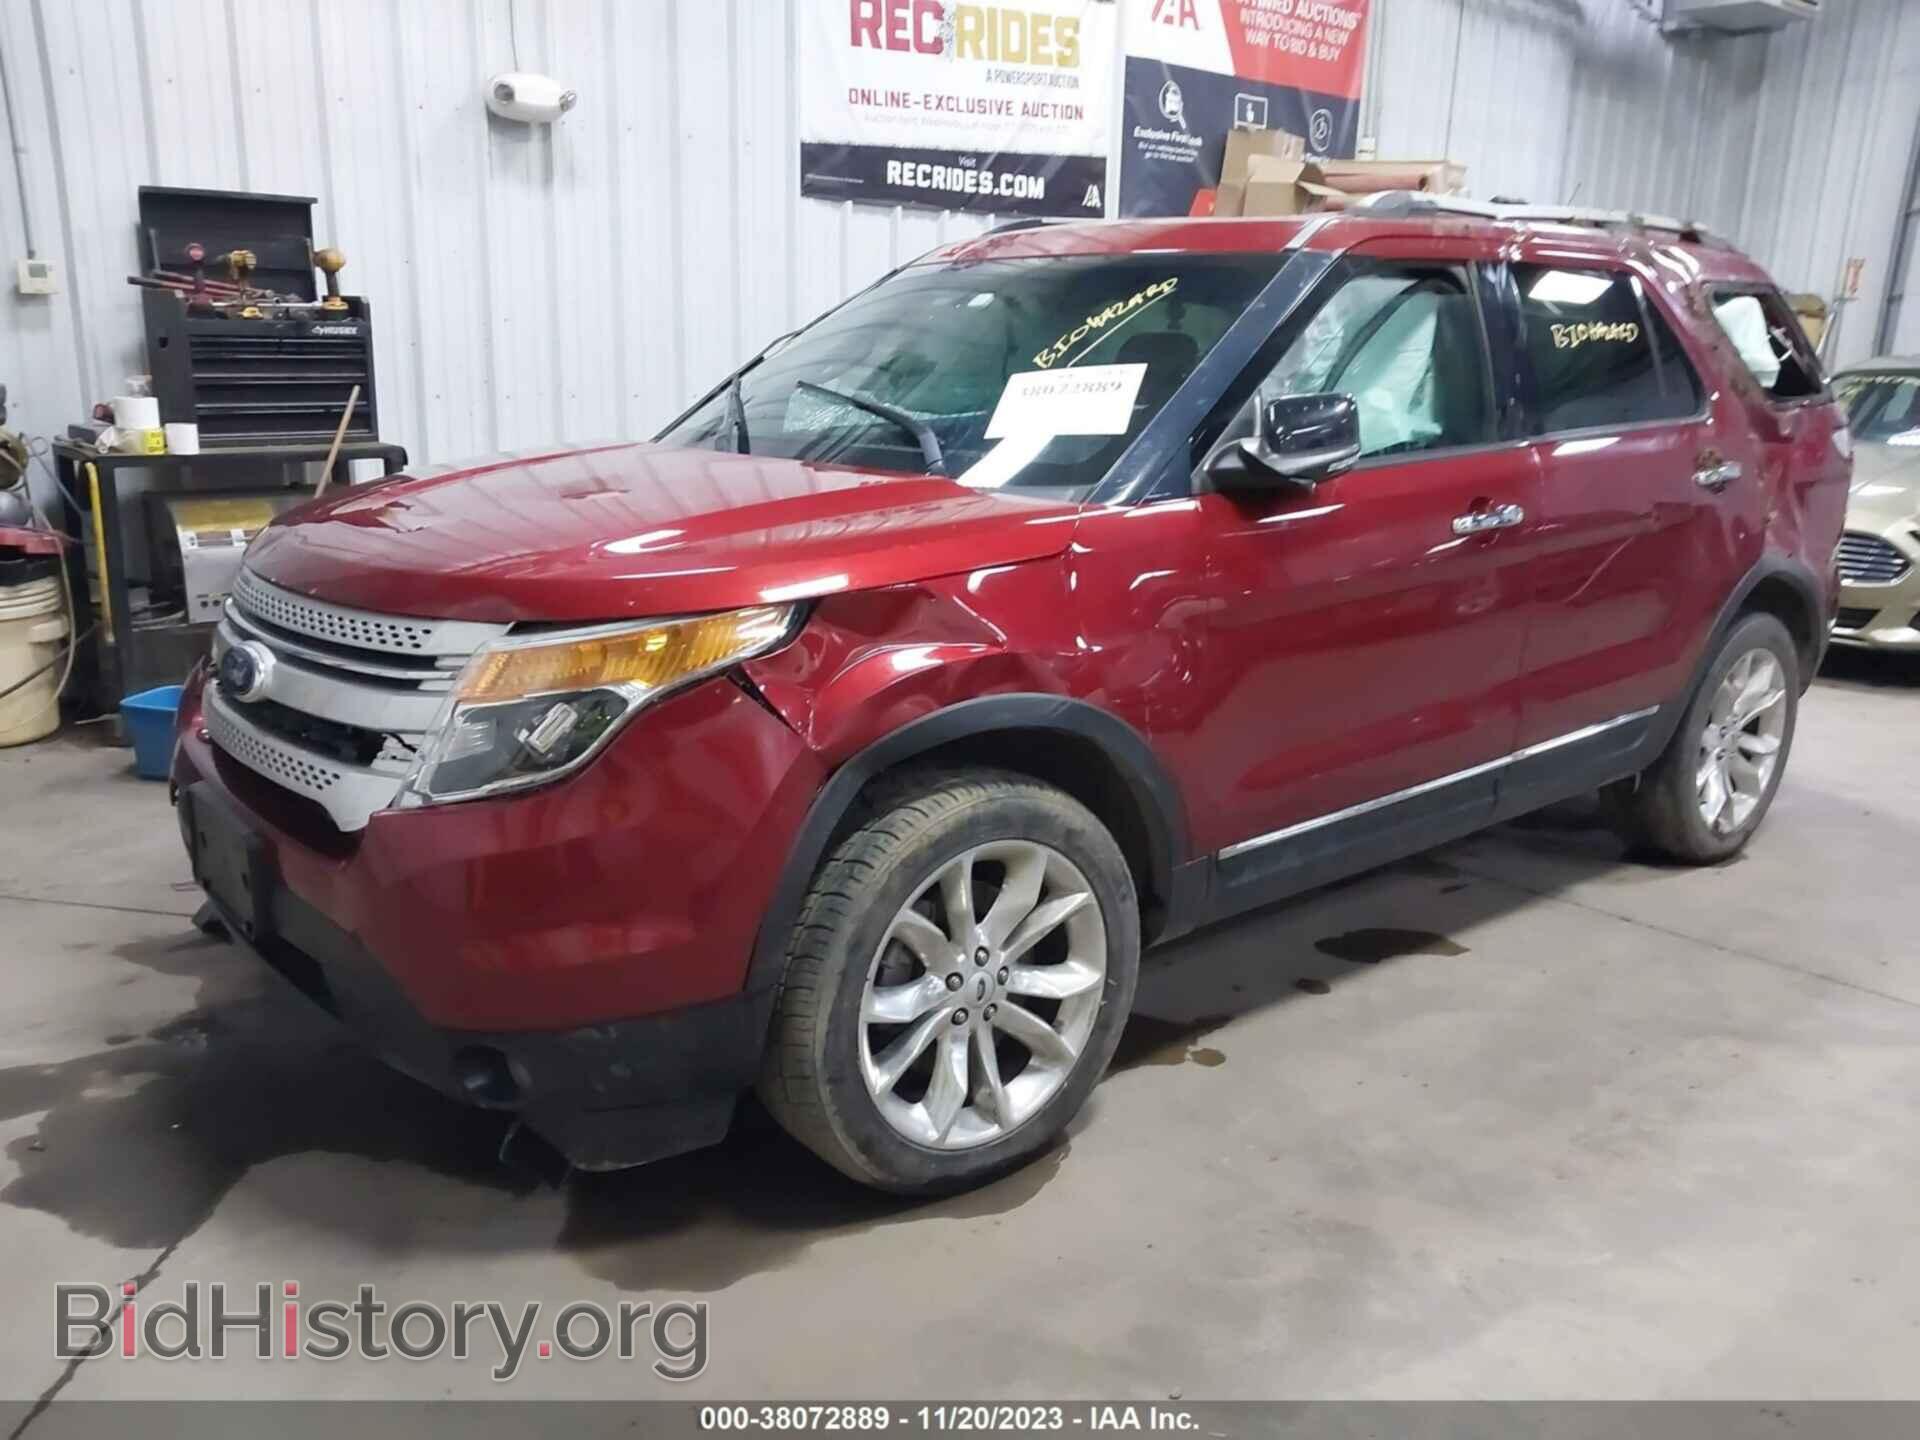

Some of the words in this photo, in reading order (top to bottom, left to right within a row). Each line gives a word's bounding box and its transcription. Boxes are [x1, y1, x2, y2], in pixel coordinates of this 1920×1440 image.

[849, 0, 945, 54] REC
[955, 4, 1080, 68] RIDES
[1239, 8, 1313, 38] INTRODUCING
[1244, 27, 1271, 48] WAY
[1272, 32, 1289, 51] TO
[848, 87, 1014, 117] ONLINE-EXCLUSIVE
[1021, 101, 1084, 120] AUCTION
[886, 160, 1045, 199] RECRIDES.COM
